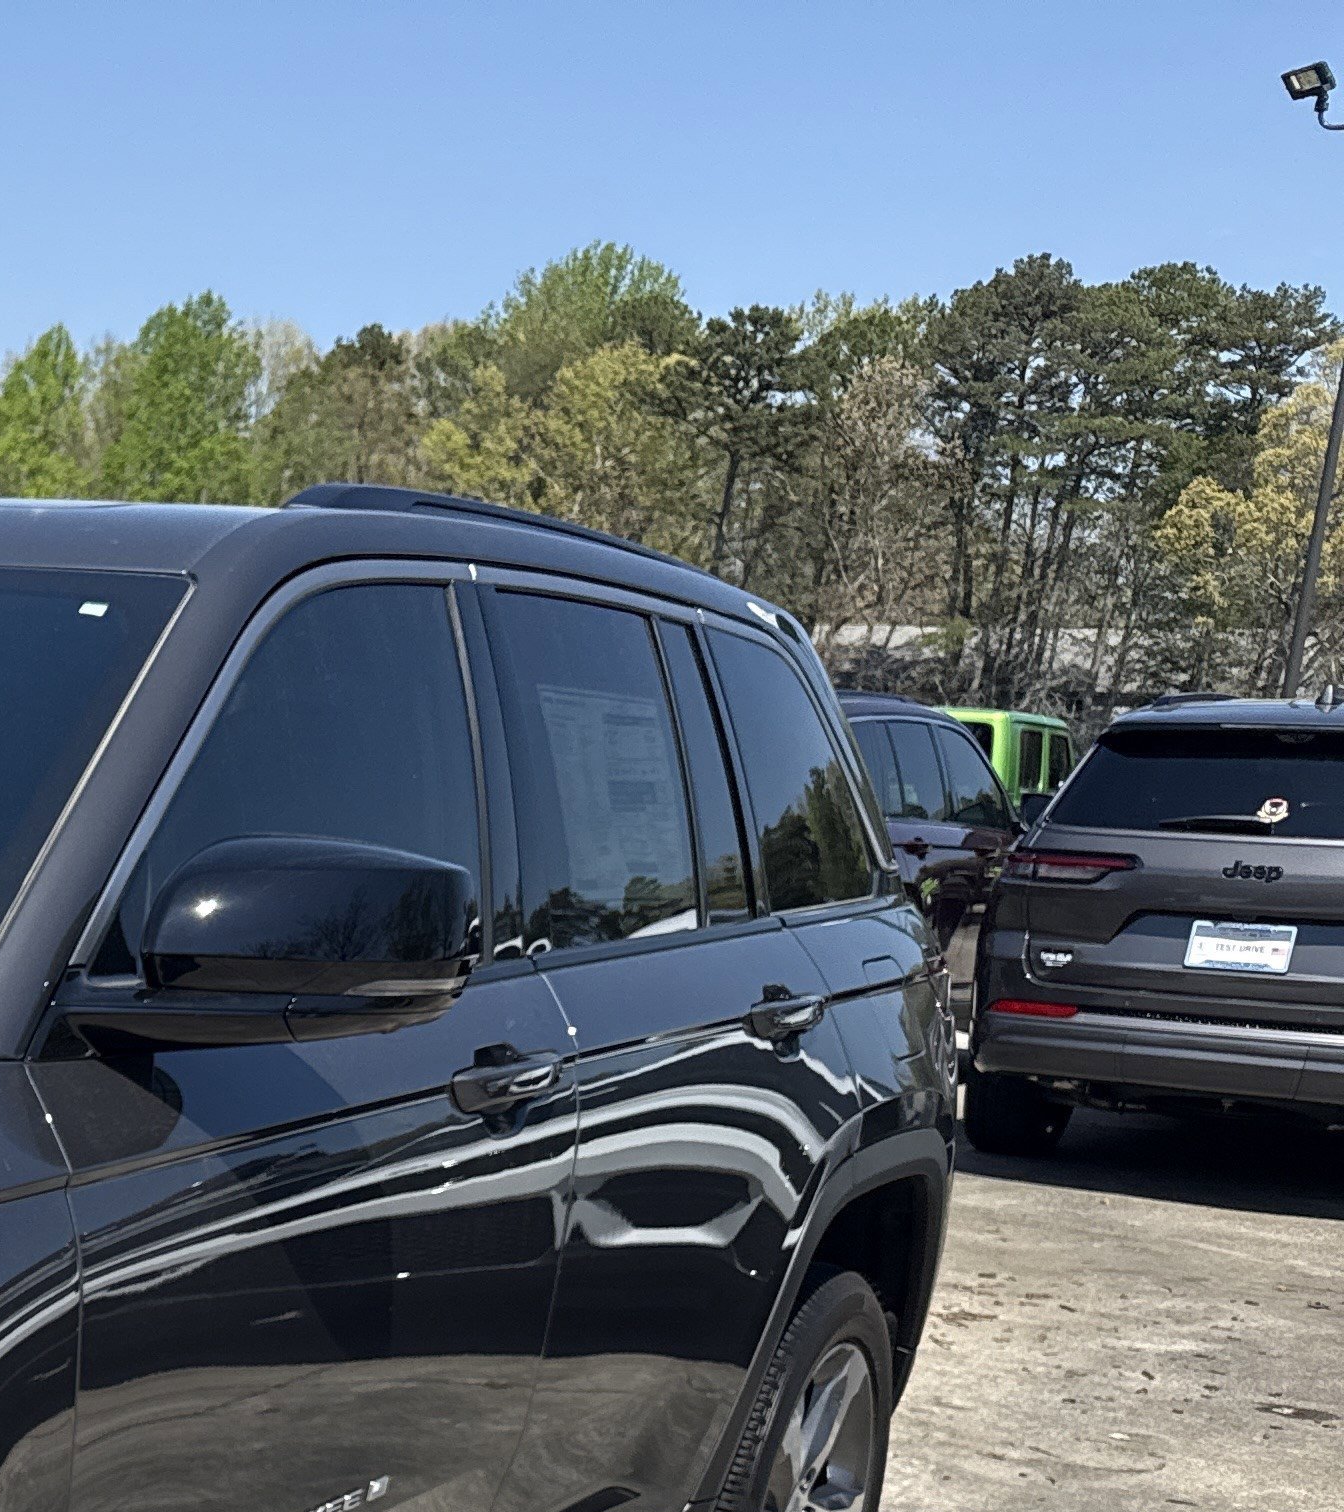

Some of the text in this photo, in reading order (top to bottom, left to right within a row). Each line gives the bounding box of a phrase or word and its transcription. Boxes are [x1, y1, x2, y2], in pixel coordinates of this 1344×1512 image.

[1221, 860, 1285, 883] Jeep
[1215, 942, 1266, 954] TEST DRIVE
